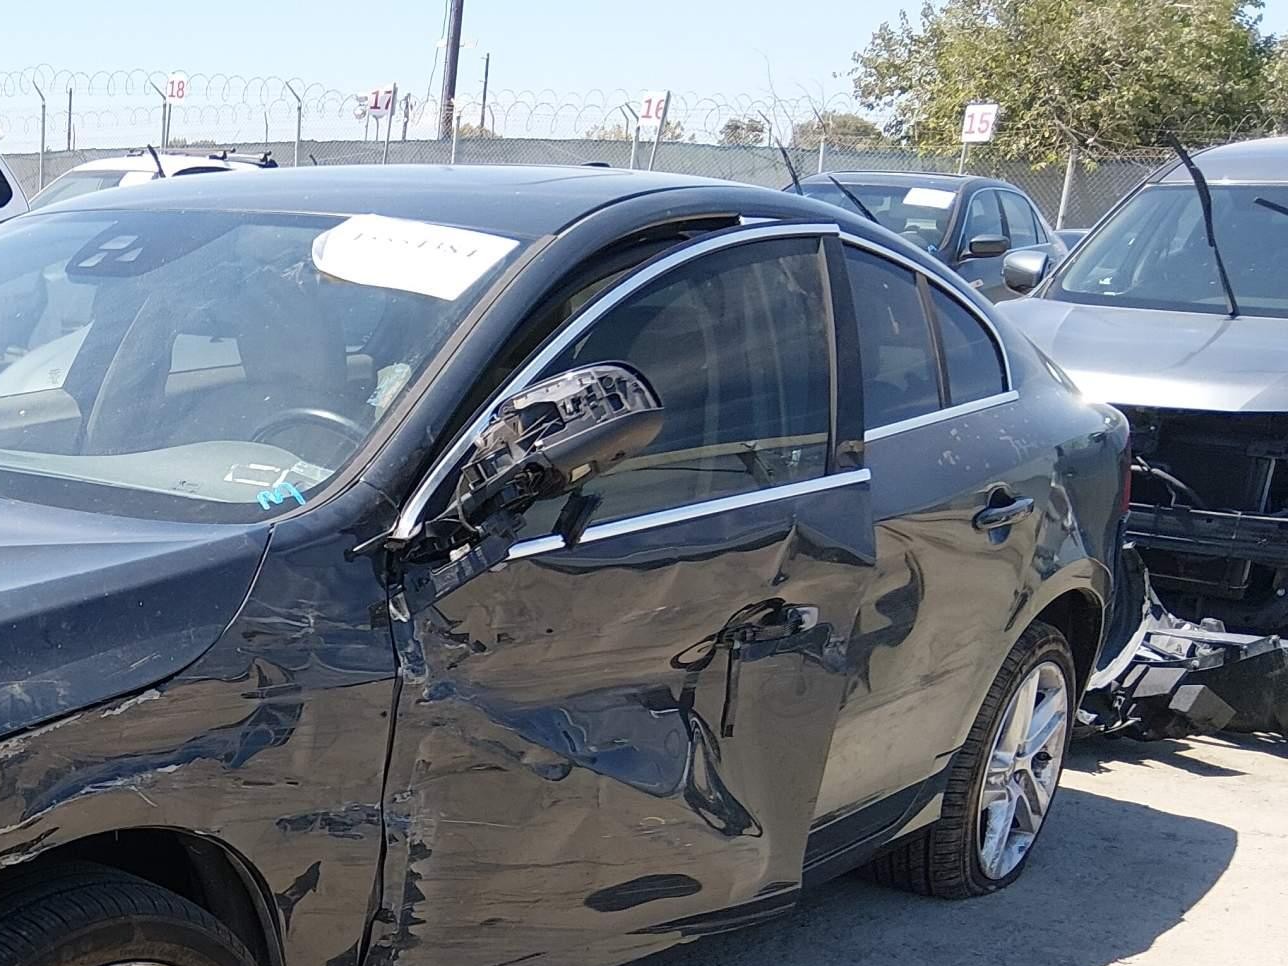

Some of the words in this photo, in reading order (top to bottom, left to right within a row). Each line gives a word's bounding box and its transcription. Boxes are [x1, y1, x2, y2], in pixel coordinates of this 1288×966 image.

[168, 80, 185, 99] 18
[370, 90, 392, 111] 17
[964, 112, 993, 134] 15
